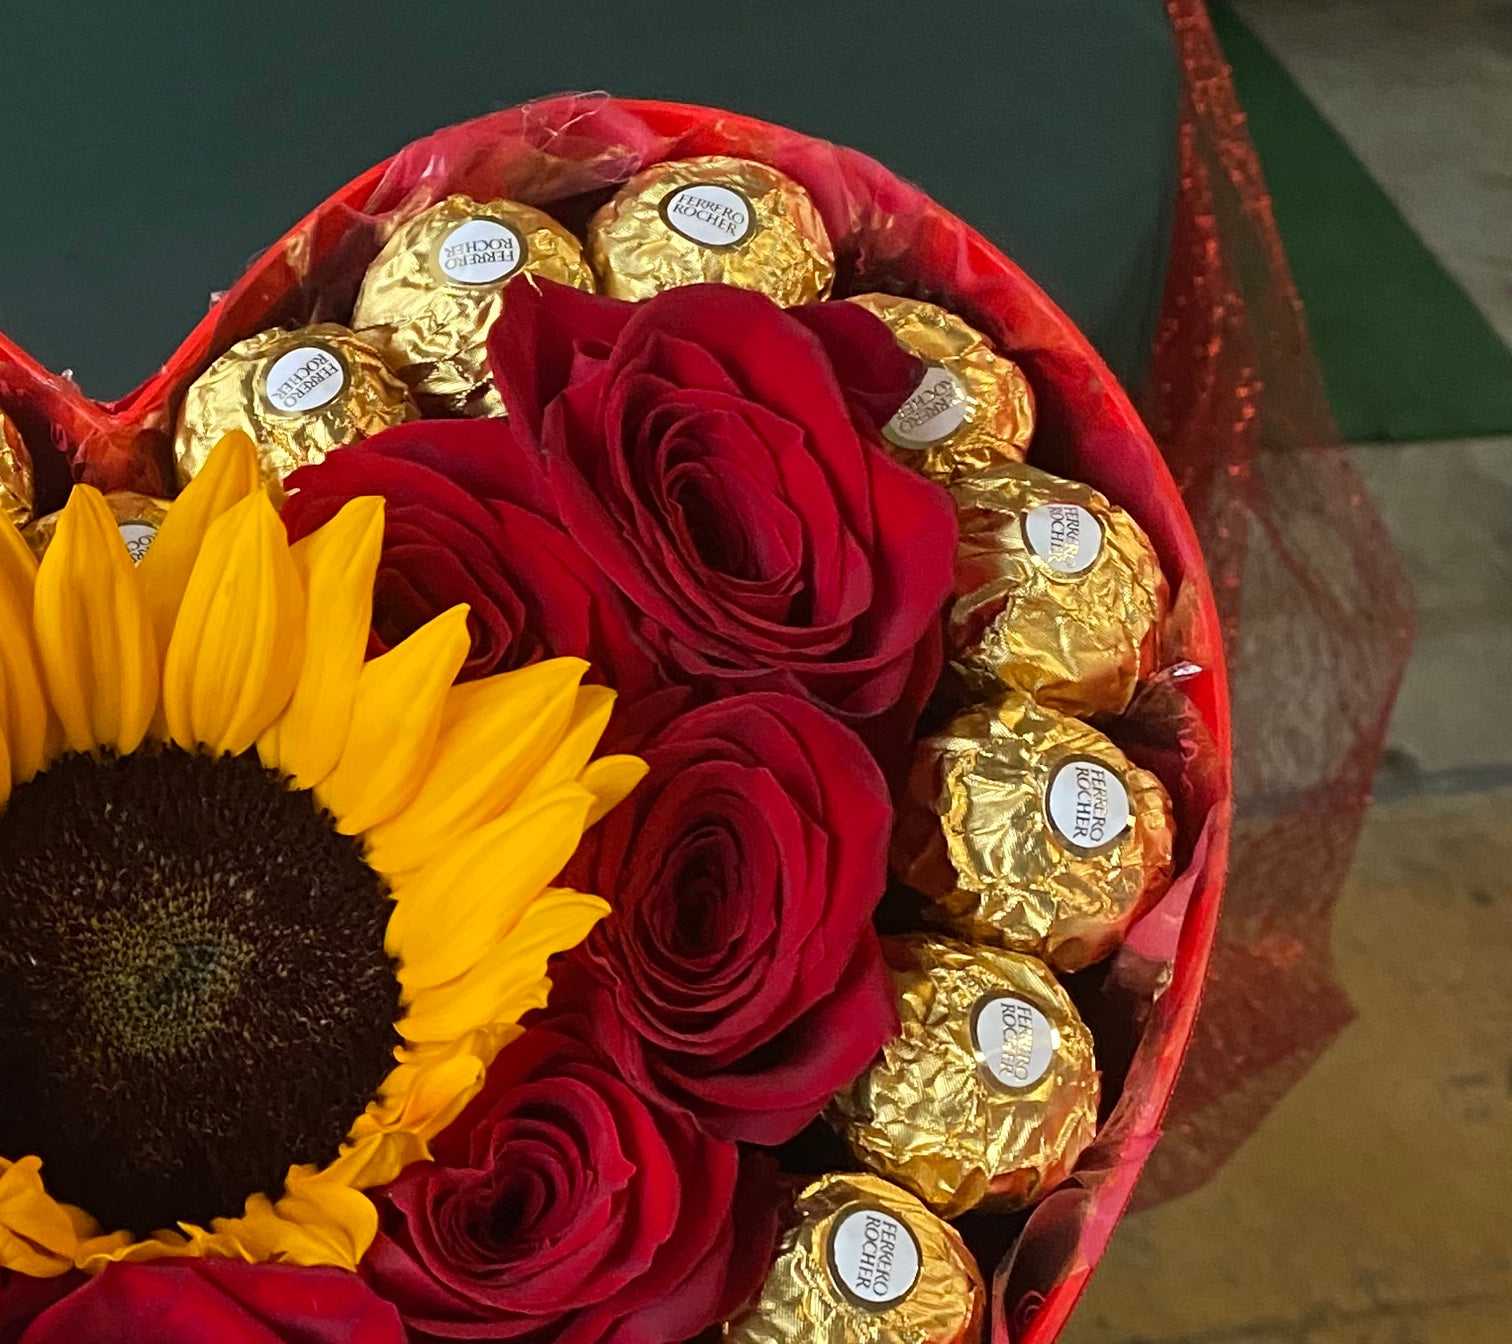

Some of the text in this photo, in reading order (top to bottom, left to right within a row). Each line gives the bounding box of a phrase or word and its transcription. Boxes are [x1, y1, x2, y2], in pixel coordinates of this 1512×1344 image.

[672, 203, 737, 236] ROCHER
[677, 194, 744, 225] FERRERO
[445, 237, 513, 256] ROCHER
[445, 250, 514, 270] FERRERO
[271, 353, 328, 399] ROCHER
[284, 362, 339, 408] FERRERO
[1073, 767, 1091, 839] ROCHER
[1089, 769, 1107, 842] FERRERO
[856, 1216, 881, 1289] ROCHER
[872, 1220, 897, 1296] FERRERO
